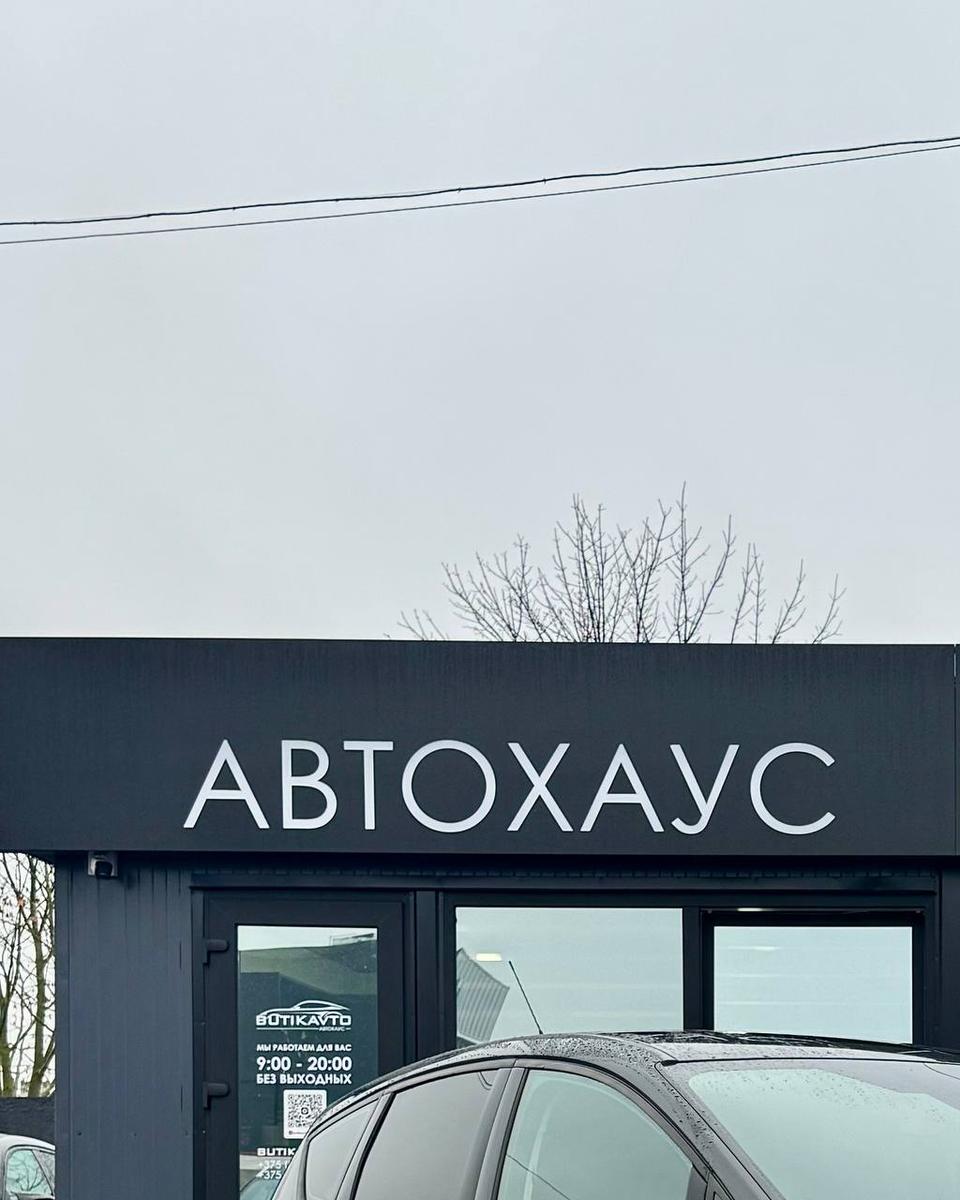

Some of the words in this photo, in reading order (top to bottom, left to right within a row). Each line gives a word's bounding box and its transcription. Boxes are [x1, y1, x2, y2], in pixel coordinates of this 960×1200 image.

[184, 739, 837, 836] АВТОХАУС
[256, 1014, 352, 1026] BUTIKAVTO
[256, 1043, 271, 1052] МЫ
[272, 1043, 315, 1052] РАБОТАЕМ
[316, 1043, 333, 1052] ДЛЯ
[334, 1043, 352, 1052] ВАС
[256, 1056, 291, 1071] 9:00
[307, 1056, 352, 1071] 20:00
[256, 1074, 277, 1085] БЕЗ
[280, 1074, 352, 1085] ВЫХОДНЫХ
[257, 1147, 297, 1156] BUTIK
